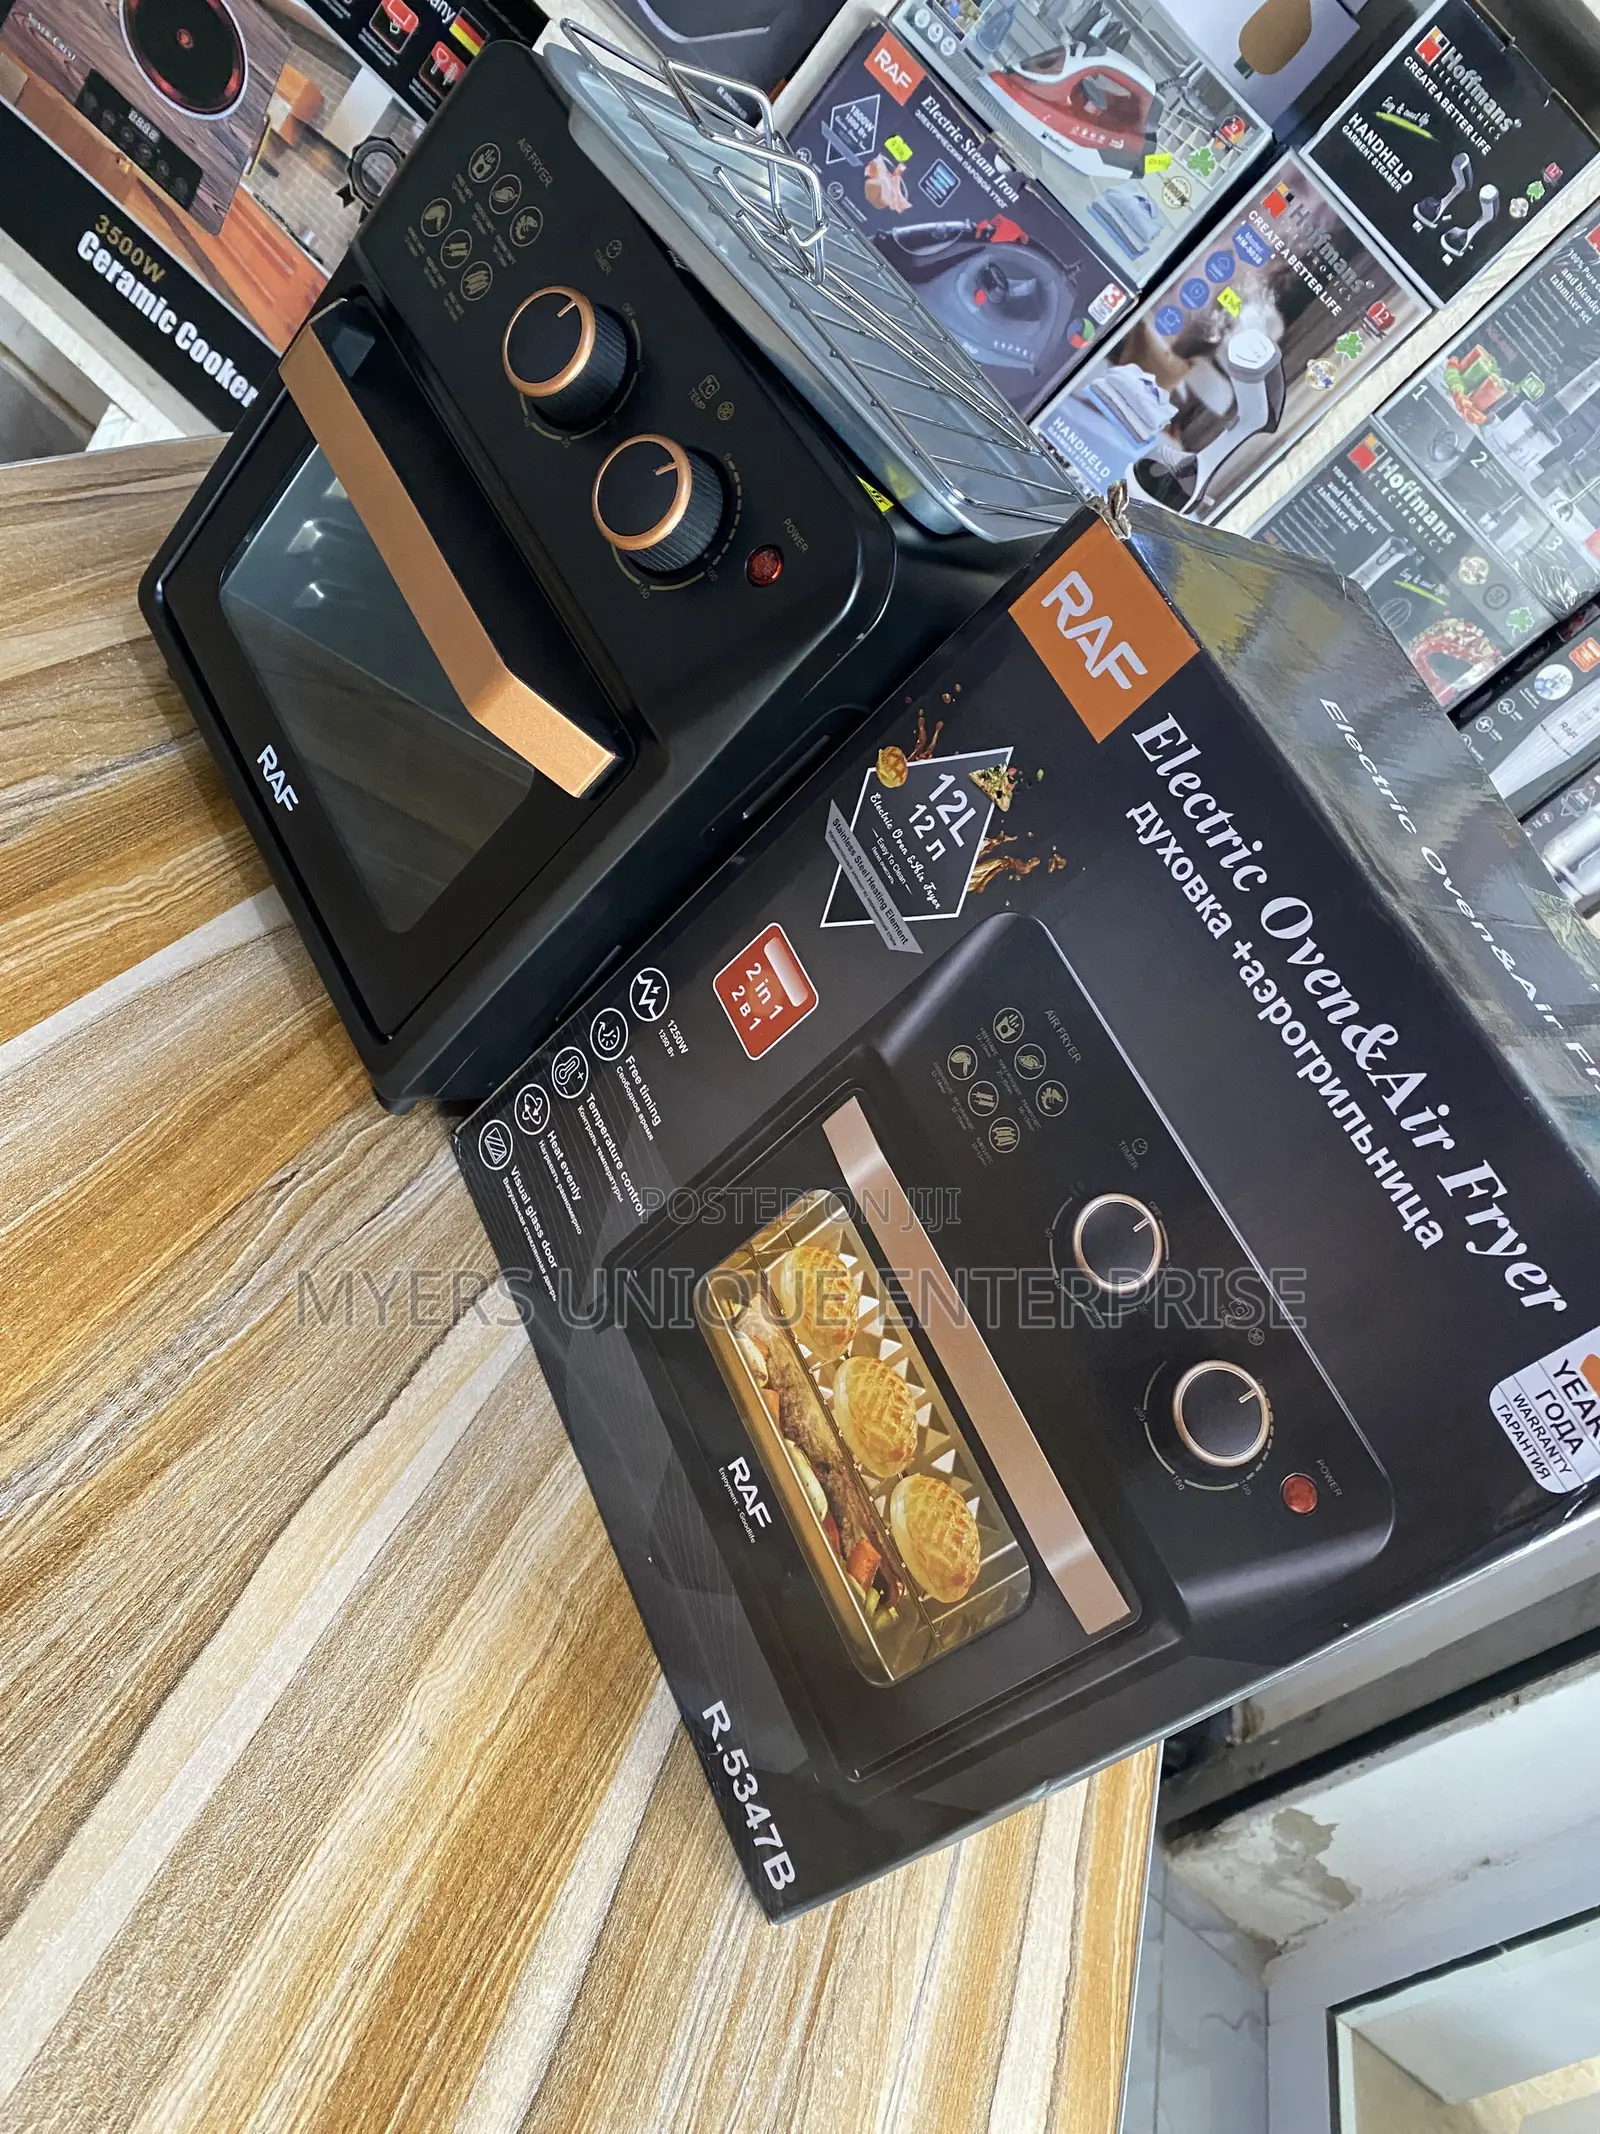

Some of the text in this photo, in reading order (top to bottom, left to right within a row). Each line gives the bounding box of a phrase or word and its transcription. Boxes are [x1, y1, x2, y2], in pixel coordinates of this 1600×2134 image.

[874, 47, 913, 89] RAF
[1402, 55, 1438, 95] CREATE
[1433, 90, 1445, 102] A
[1439, 97, 1474, 136] BETTER
[1469, 131, 1491, 156] LIFE
[515, 137, 554, 188] AIR FRYER
[920, 94, 966, 144] Electric
[959, 136, 998, 178] Steam
[992, 171, 1022, 203] Iron
[1340, 124, 1403, 192] GARMENT STEAMER
[1347, 112, 1415, 185] HANDHELD
[95, 215, 166, 283] 3500W
[1247, 209, 1342, 316] CREATE A BETTER LIFE
[1561, 268, 1579, 285] and
[1582, 267, 1596, 284] Pure
[77, 230, 258, 408] Ceramic Cooker
[1550, 274, 1582, 311] tabmixer
[1579, 311, 1592, 324] set
[1412, 384, 1428, 401] 1
[1052, 417, 1110, 479] HANDHELD
[1471, 451, 1487, 468] 2
[783, 517, 809, 554] POWER
[1547, 536, 1562, 551] 3
[1041, 570, 1148, 689] RAF
[257, 744, 299, 812] RAF
[928, 773, 977, 847] 12L
[868, 791, 896, 830] Electric
[890, 827, 912, 855] Oven
[921, 880, 943, 911] Fryer
[909, 804, 936, 839] 12
[831, 818, 909, 945] Stainless Steel Heating Element
[876, 837, 908, 884] Easy To Clean
[1320, 698, 1417, 835] Electric
[1421, 846, 1563, 1029] Oven&Air
[731, 985, 746, 1002] 2
[746, 962, 762, 981] 2
[753, 979, 771, 1004] in
[658, 1028, 671, 1048] 1250
[667, 1019, 689, 1054] 1250W
[1044, 1007, 1082, 1064] AIR FRYER
[1126, 802, 1444, 1250] духовка +аэрогрильница
[1132, 712, 1567, 1312] Electric Oven&Air Fryer
[623, 1054, 664, 1127] Free timing
[545, 1129, 584, 1202] Heat evenly
[583, 1093, 646, 1216] Temperature control
[507, 1165, 561, 1270] Visual glass door
[1131, 1404, 1146, 1422] 200
[1498, 1404, 1551, 1479] ГАРАНТИЯ
[1513, 1393, 1572, 1474] WARRANTY
[1536, 1389, 1584, 1455] ГОДА
[718, 1466, 757, 1544] Enjoyment Goodlife
[727, 1456, 772, 1528] RAF
[1171, 1474, 1185, 1491] 150
[1315, 1458, 1342, 1497] POWER
[702, 1700, 796, 1891] R.5347B
